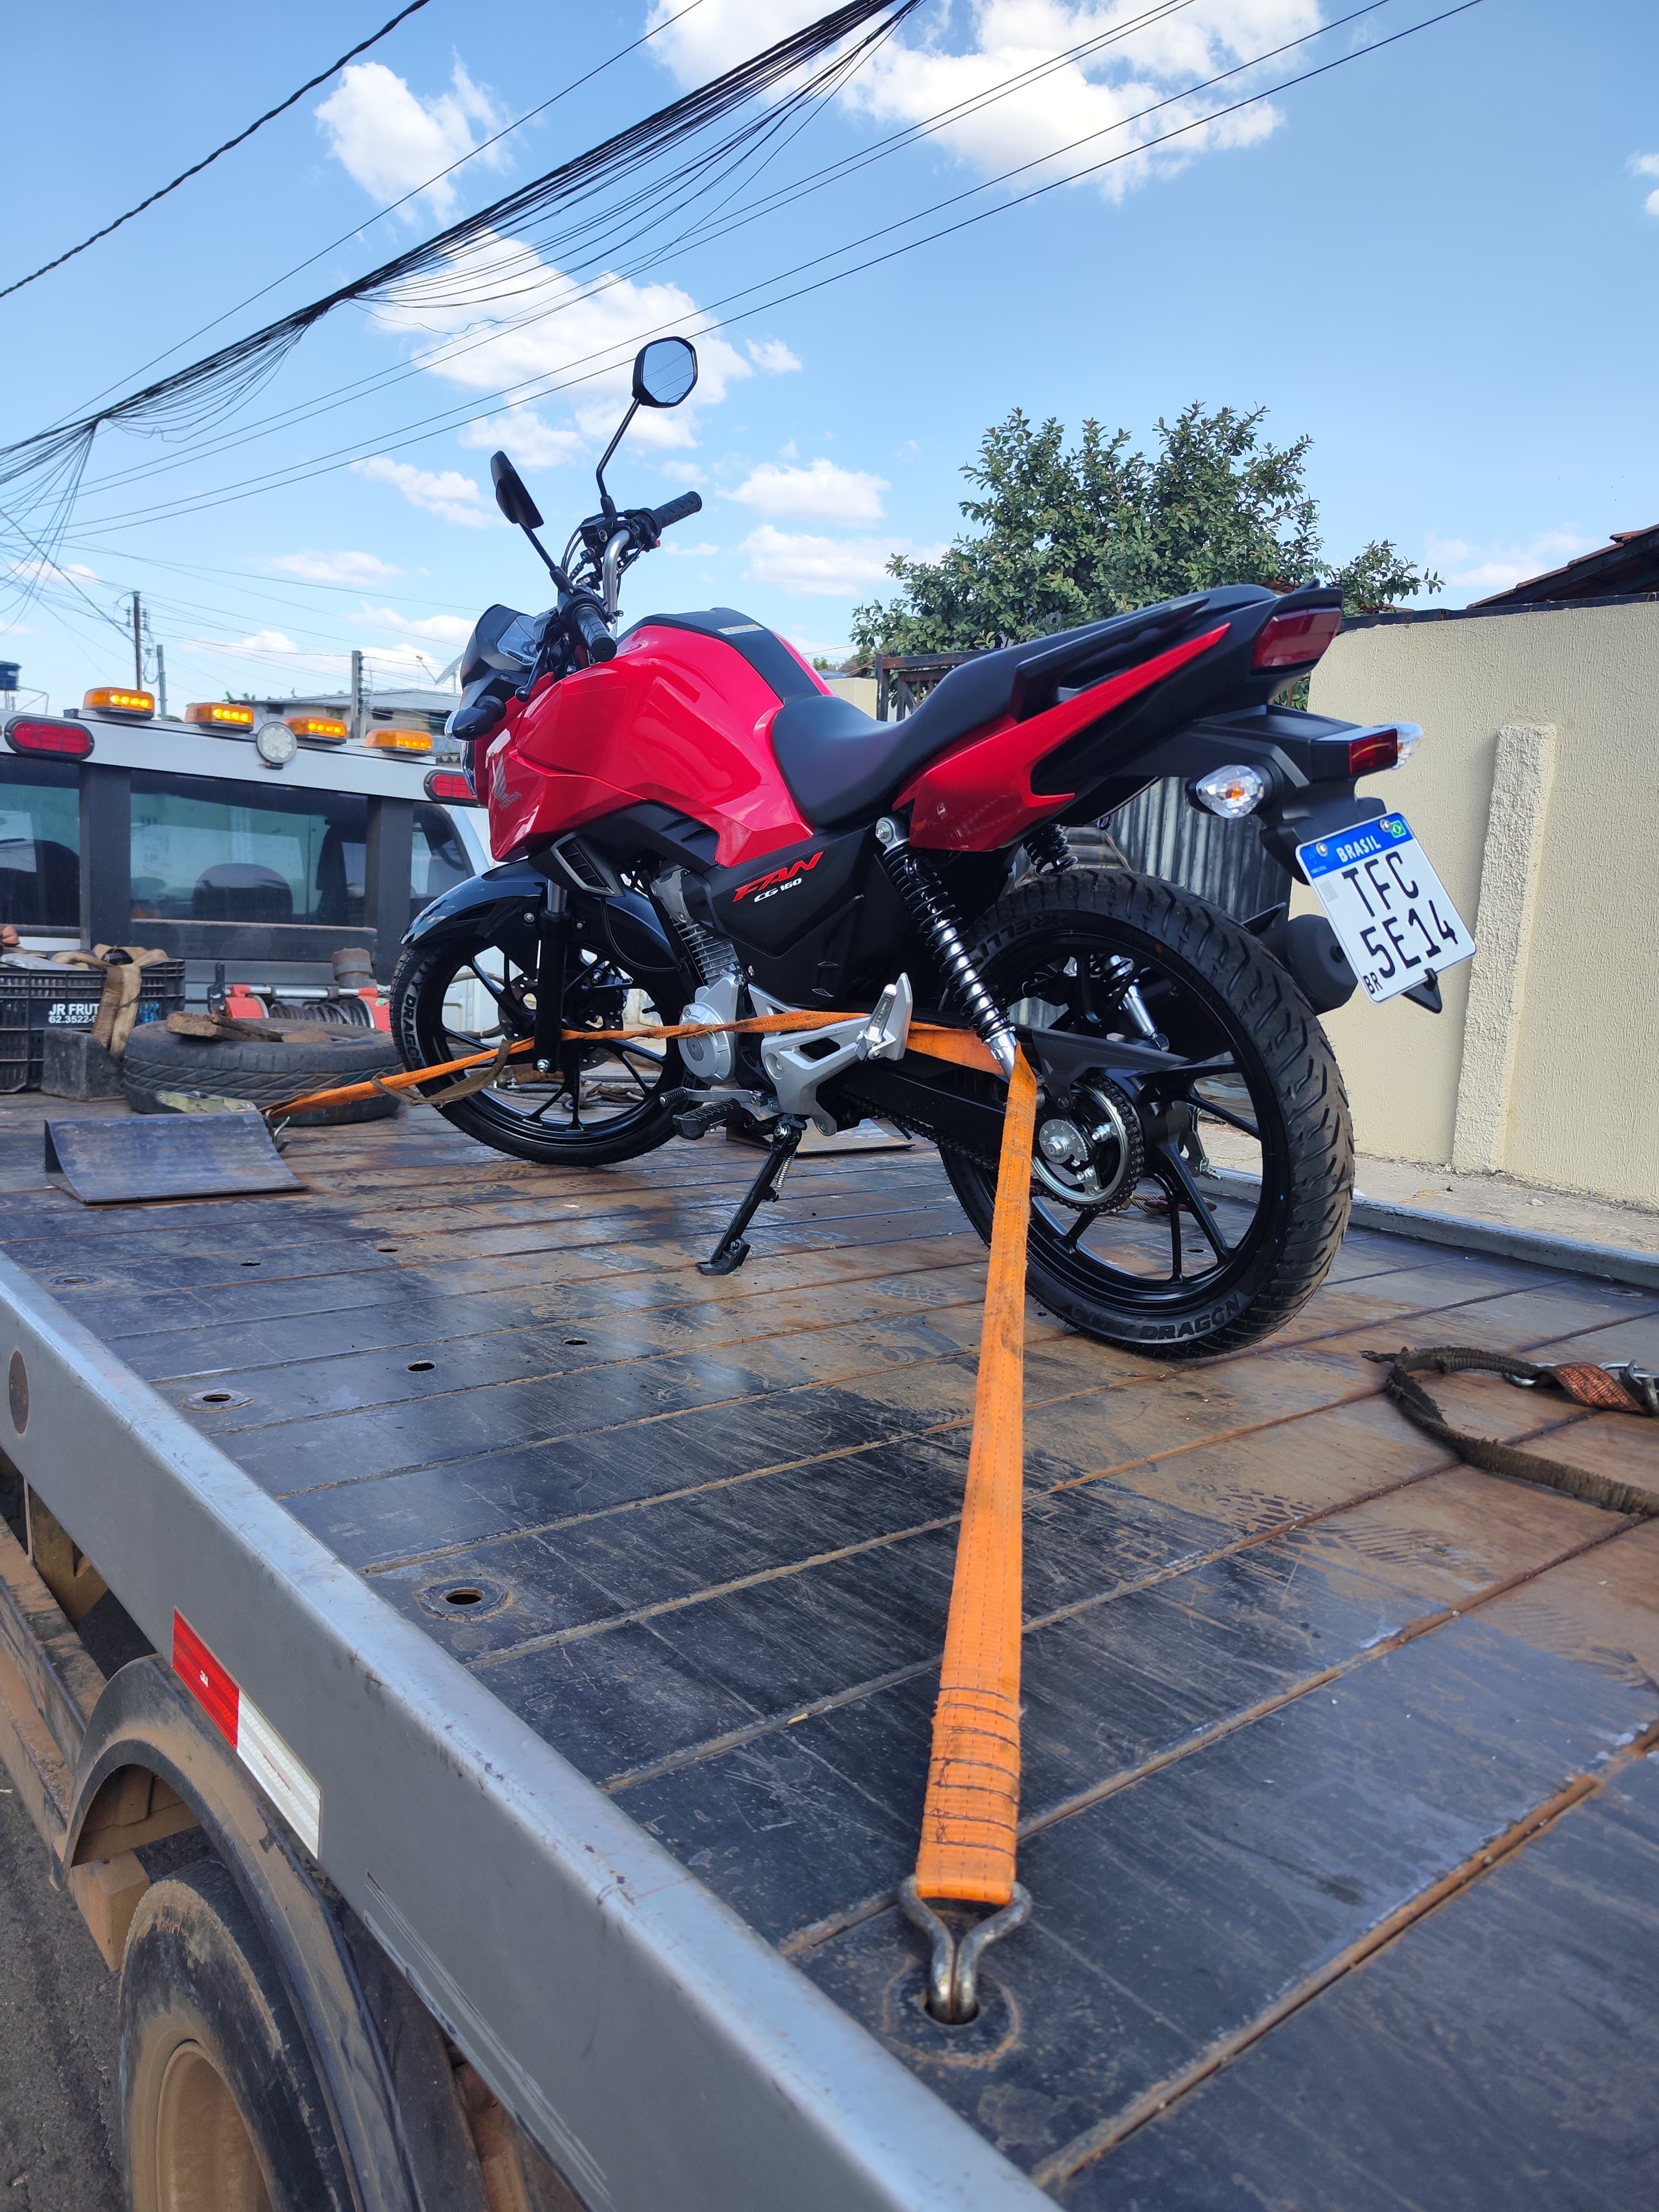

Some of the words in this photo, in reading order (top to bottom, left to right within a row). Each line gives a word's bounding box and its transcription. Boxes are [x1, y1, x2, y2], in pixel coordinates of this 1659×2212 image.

[498, 791, 522, 811] HONDA
[1336, 835, 1381, 863] BRASIL
[732, 851, 825, 902] FAN
[754, 887, 779, 903] CG
[780, 877, 802, 892] 160
[1341, 851, 1419, 917] TFC
[980, 915, 1061, 958] IRELLI
[1359, 900, 1458, 979] 5E14
[1363, 972, 1383, 995] BR
[49, 1003, 66, 1016] JR
[1140, 1294, 1242, 1340] DRAGON
